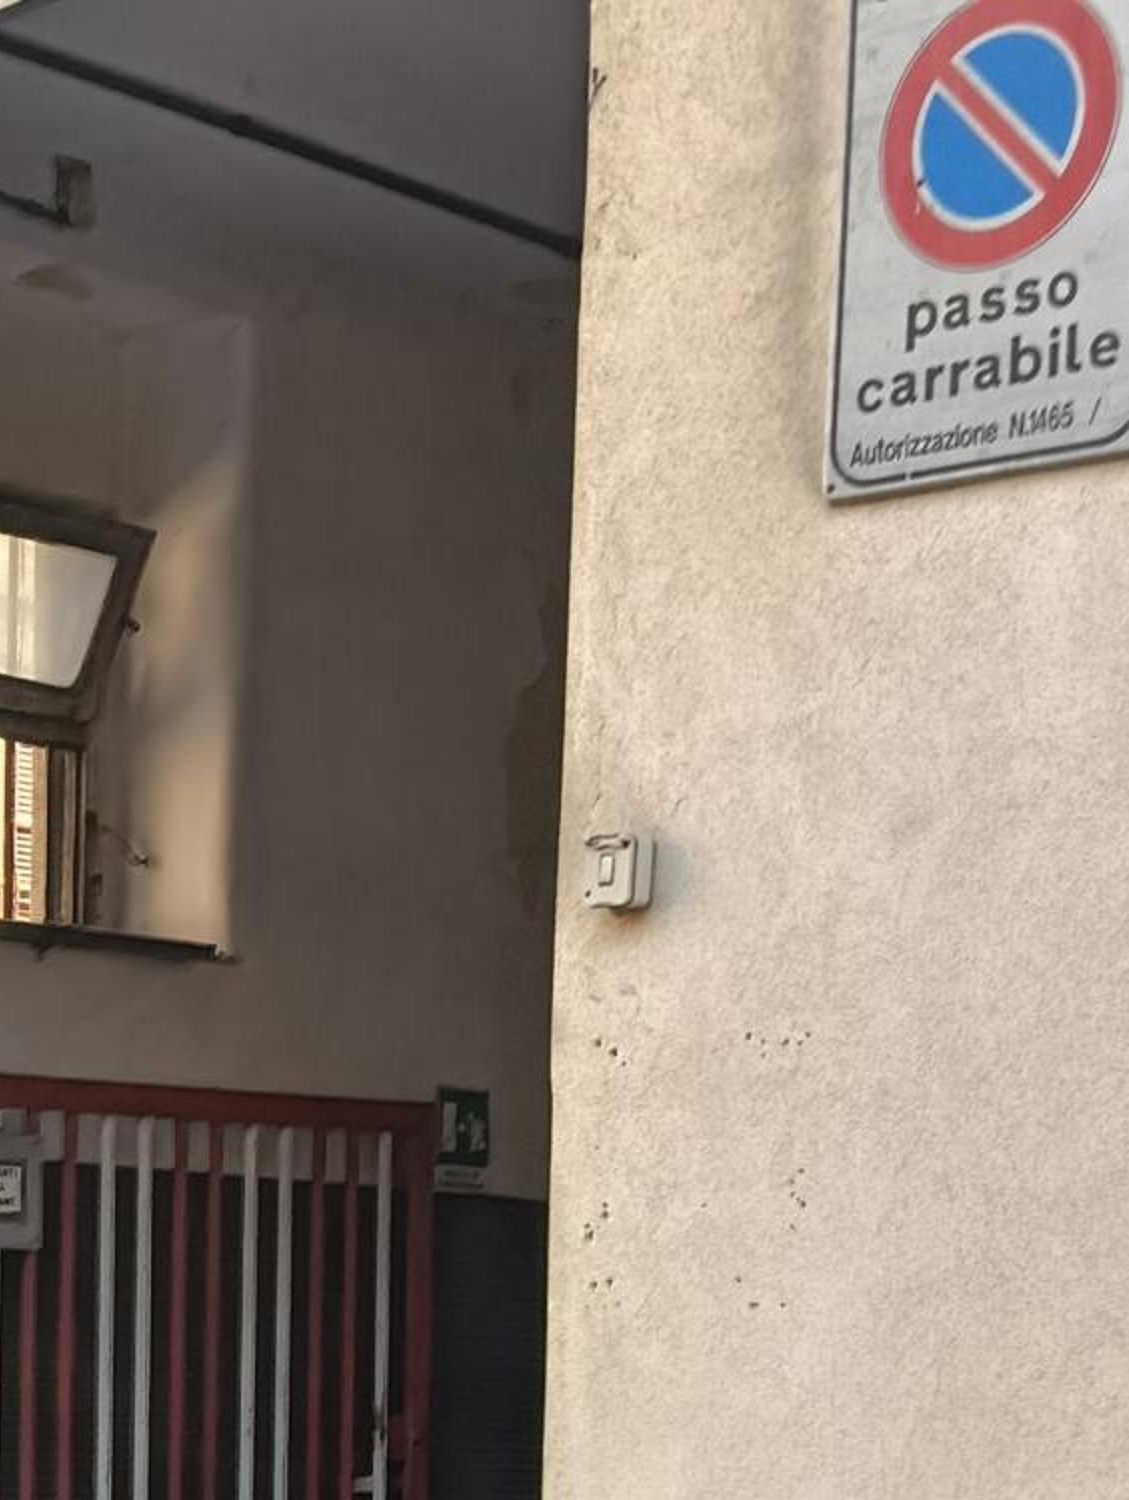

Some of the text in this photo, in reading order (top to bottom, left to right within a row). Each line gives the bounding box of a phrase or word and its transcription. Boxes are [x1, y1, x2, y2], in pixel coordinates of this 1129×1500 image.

[905, 271, 1079, 352] passo
[857, 322, 1121, 414] carrabile
[849, 420, 998, 468] Autorizzazione
